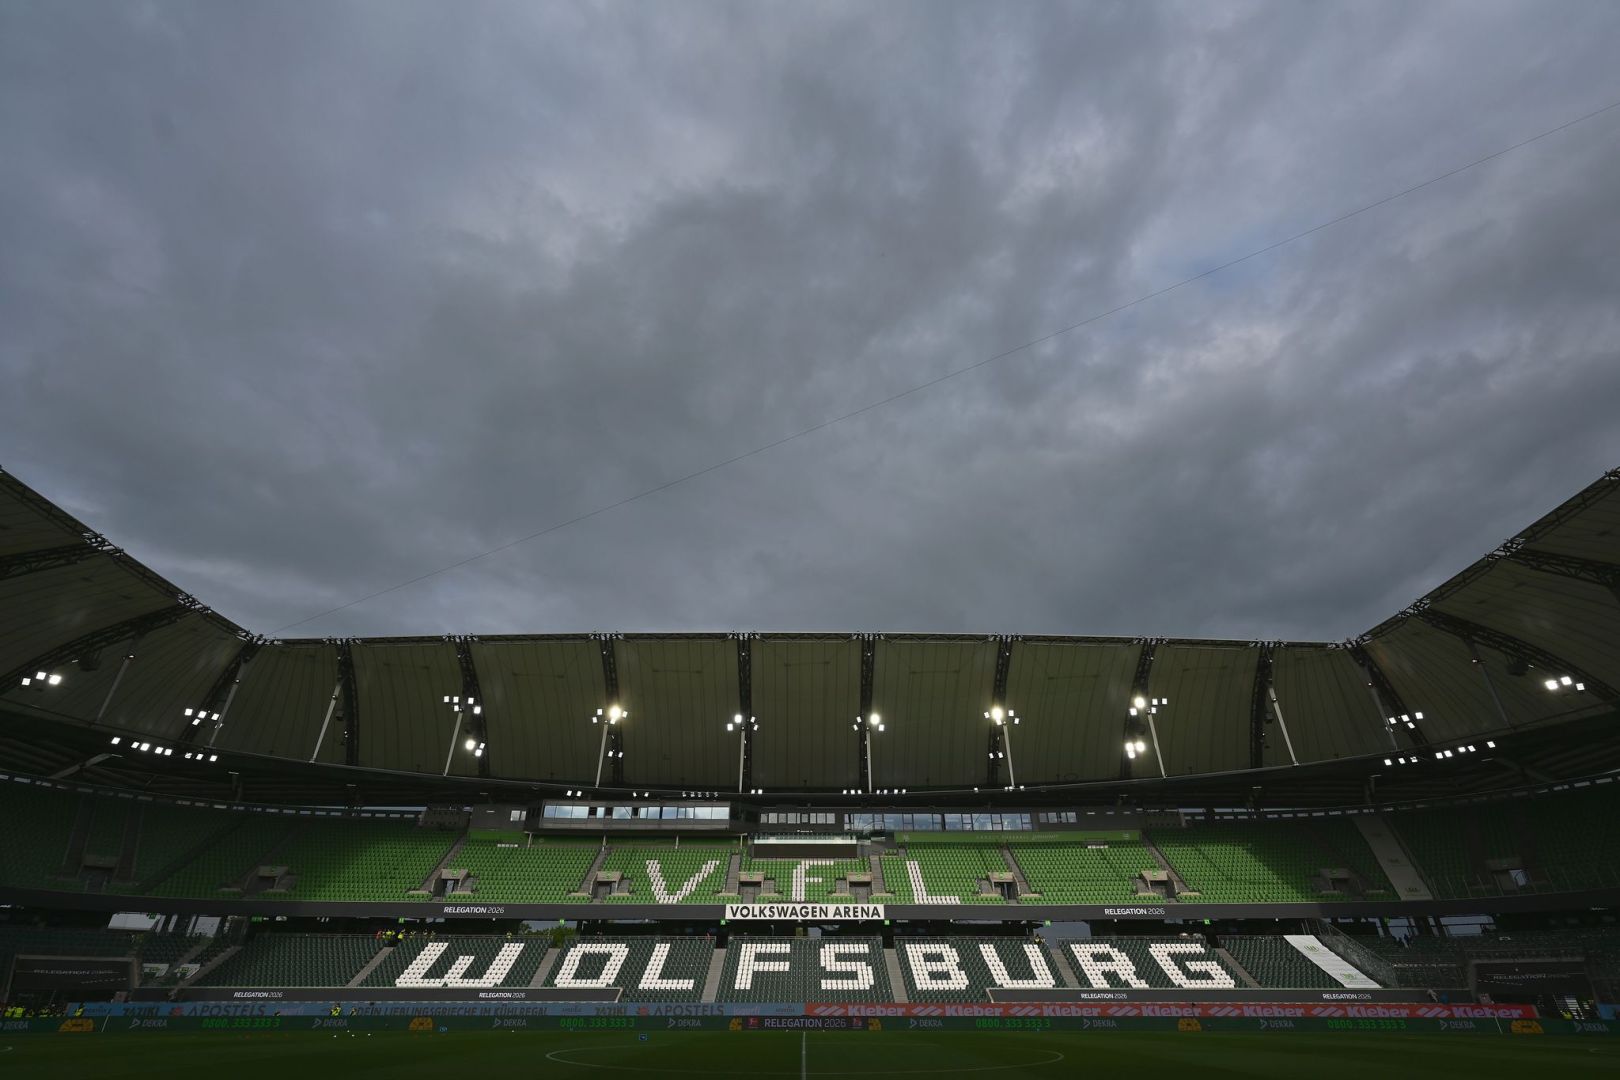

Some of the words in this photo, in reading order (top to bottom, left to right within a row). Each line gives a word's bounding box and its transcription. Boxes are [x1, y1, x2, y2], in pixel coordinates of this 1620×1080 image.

[443, 905, 487, 915] RELEGATION
[487, 906, 505, 915] 2026
[730, 905, 828, 919] VOLKSWAGEN
[833, 905, 881, 919] ARENA
[1104, 907, 1147, 916] RELEGATION
[1148, 907, 1166, 916] 2026
[395, 942, 1236, 989] WOLFSBURG
[233, 991, 269, 999] RELEGATION
[268, 991, 283, 999] 2026
[187, 1004, 266, 1016] APOSTELS
[654, 1004, 724, 1016] APOSTELS
[848, 1005, 906, 1016] Kleber
[945, 1005, 1003, 1016] Kleber
[1043, 1005, 1102, 1016] Kleber
[1141, 1005, 1202, 1017] Kleber
[1244, 1005, 1305, 1017] Kleber
[1347, 1005, 1410, 1018] Kleber
[1452, 1005, 1523, 1018] Kleber
[141, 1018, 168, 1028] DEKRA
[322, 1018, 348, 1027] DEKRA
[503, 1019, 527, 1027] DEKRA
[677, 1019, 702, 1027] DEKRA
[764, 1018, 822, 1028] RELEGATION
[824, 1018, 846, 1028] 2026
[919, 1019, 943, 1028] DEKRA
[1092, 1019, 1117, 1028] DEKRA
[1270, 1019, 1295, 1028] DEKRA
[1449, 1020, 1476, 1029] DEKRA
